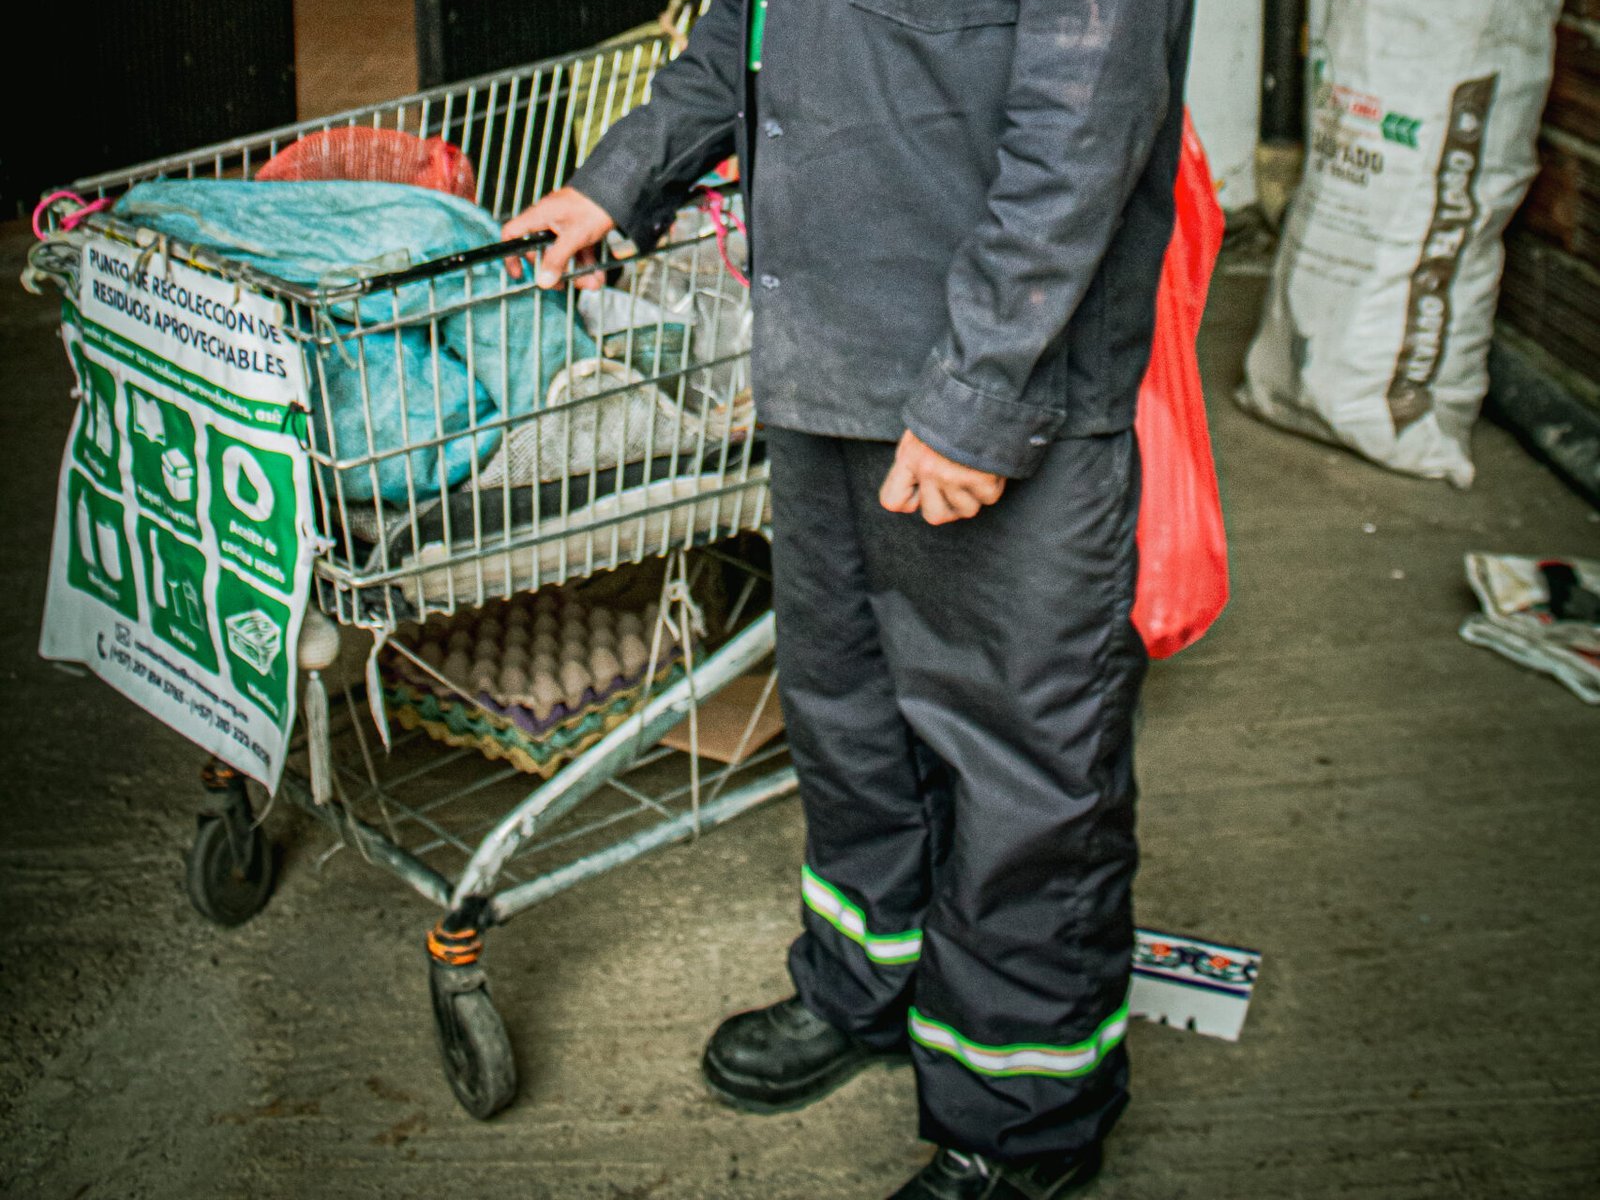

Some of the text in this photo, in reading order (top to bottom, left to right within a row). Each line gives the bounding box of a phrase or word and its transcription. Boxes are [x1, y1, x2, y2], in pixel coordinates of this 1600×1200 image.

[89, 247, 130, 282] PUNTO
[258, 318, 281, 345] DE
[93, 279, 287, 379] RESIDUOS APROVECHABLES
